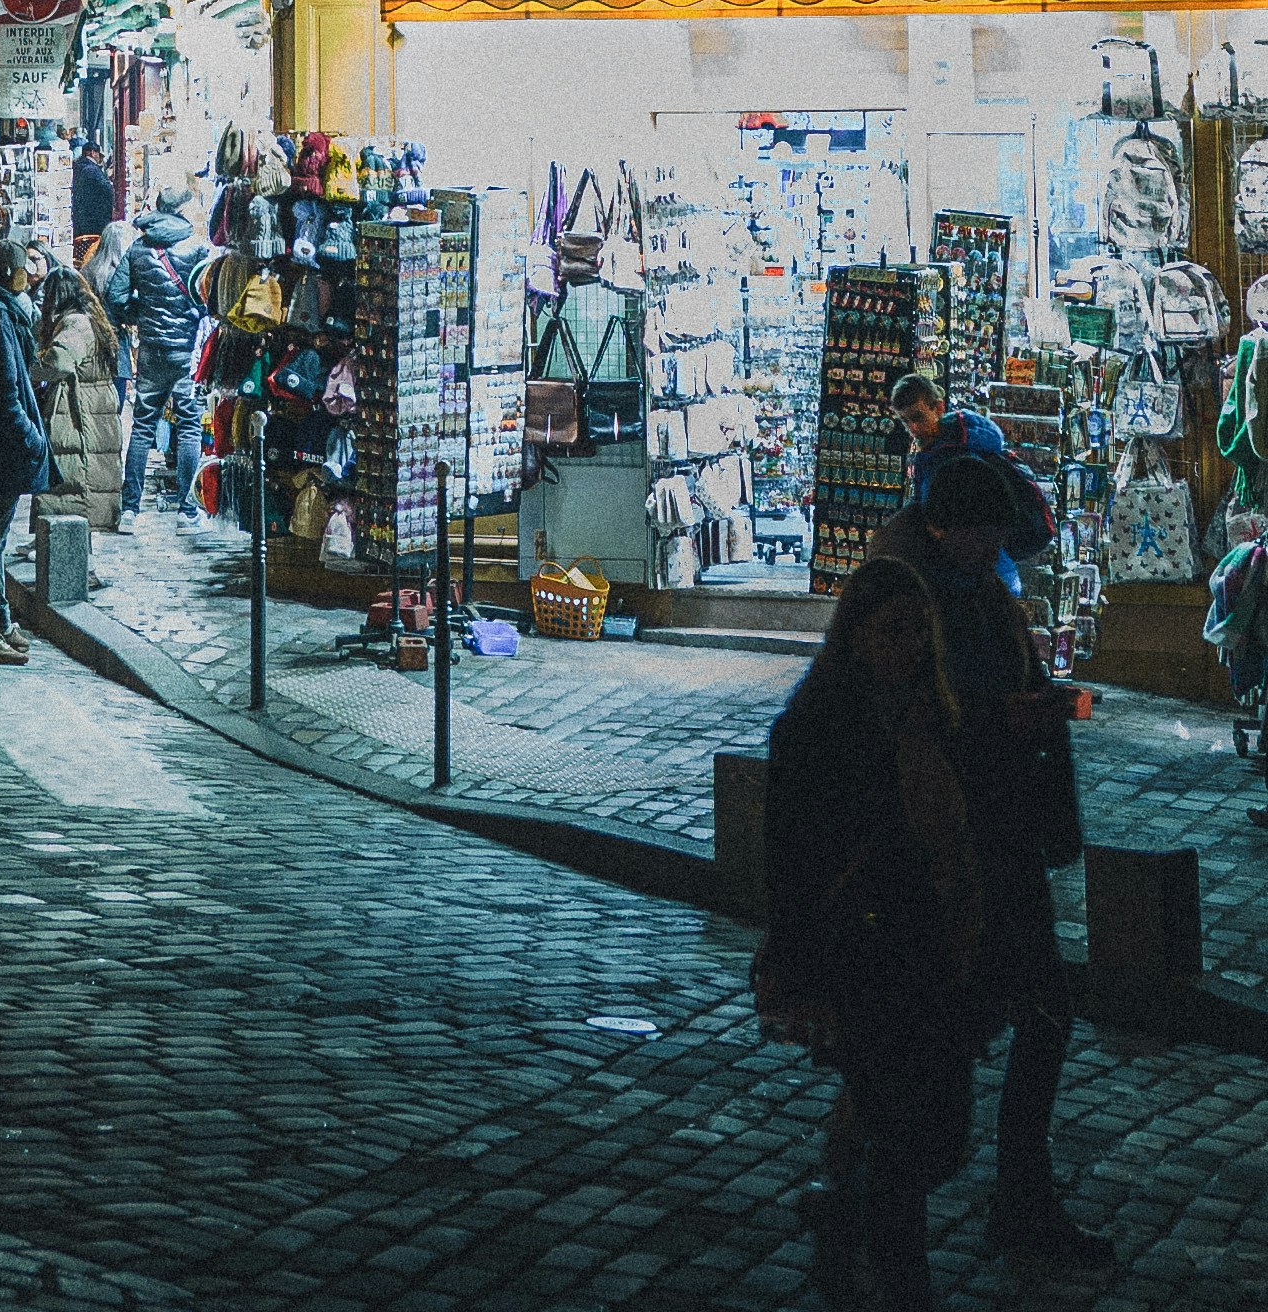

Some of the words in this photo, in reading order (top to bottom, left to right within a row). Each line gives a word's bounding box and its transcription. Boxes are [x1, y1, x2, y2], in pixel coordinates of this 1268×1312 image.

[6, 27, 55, 37] INTERDIT
[16, 47, 31, 55] AUF
[35, 47, 52, 55] AUX
[12, 71, 48, 84] SAUF
[302, 454, 324, 464] PARIS
